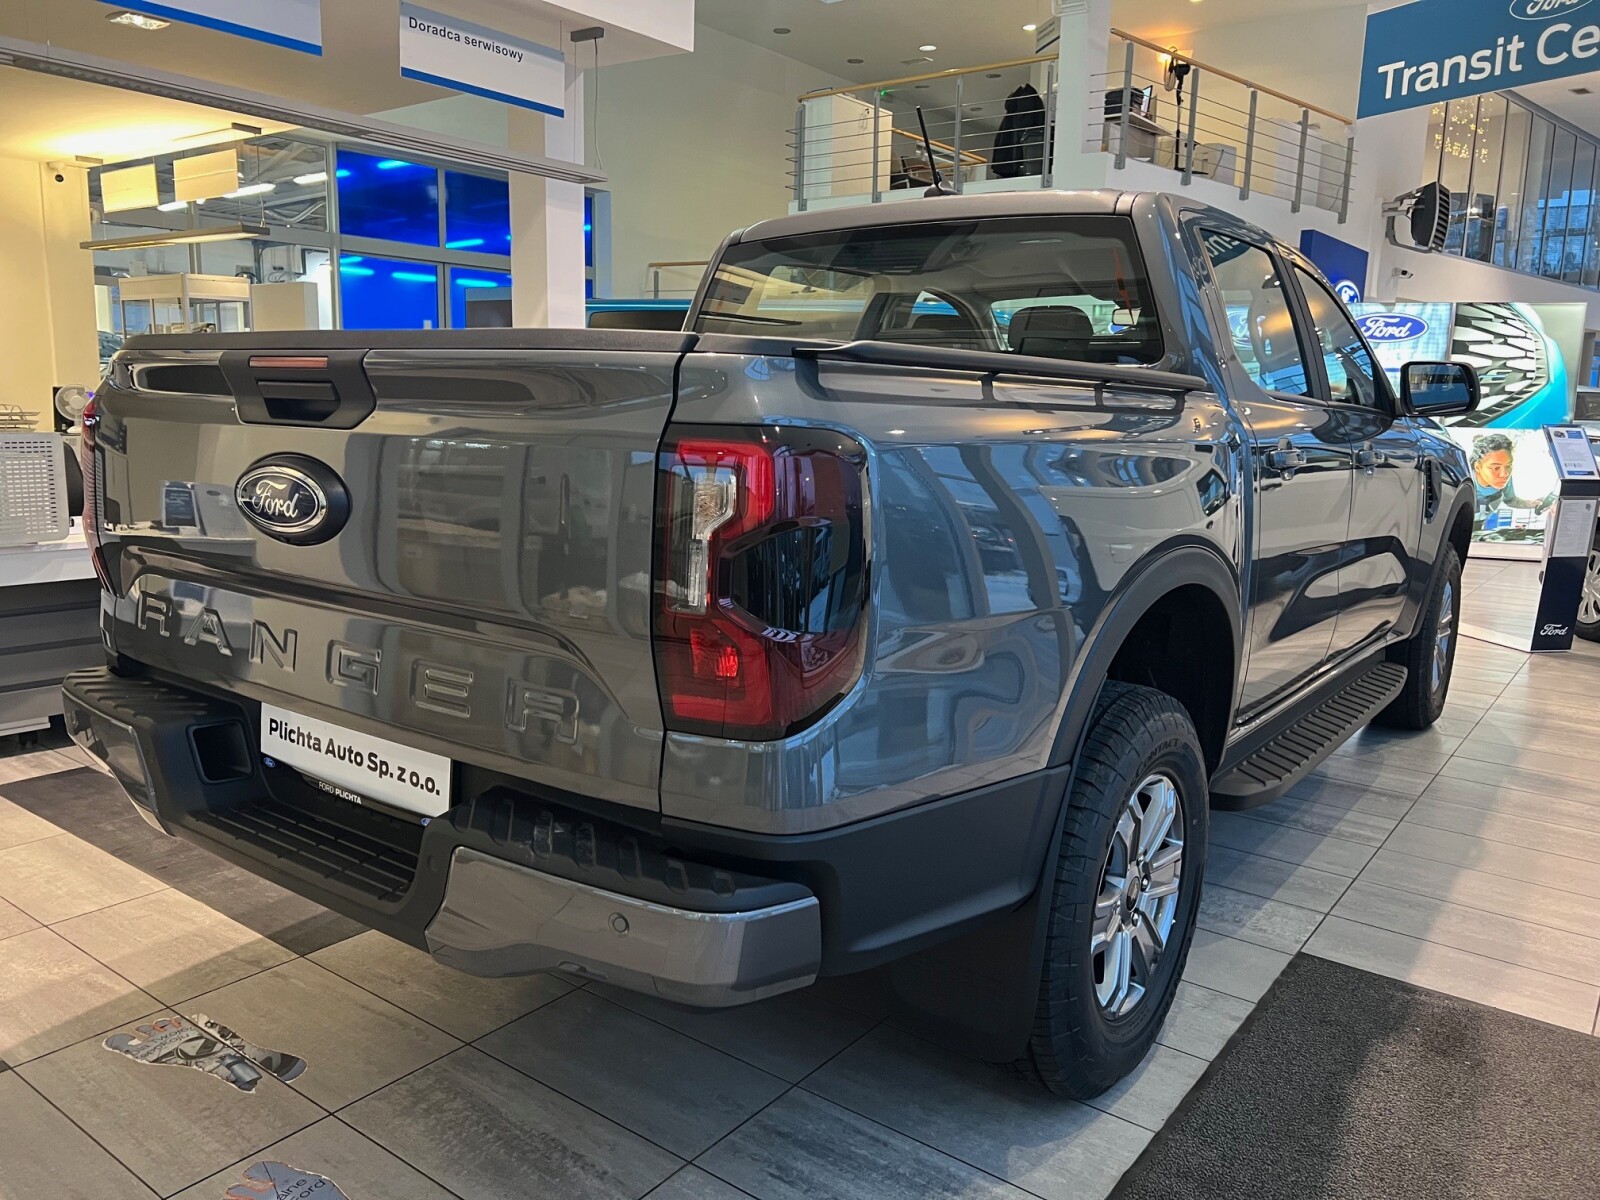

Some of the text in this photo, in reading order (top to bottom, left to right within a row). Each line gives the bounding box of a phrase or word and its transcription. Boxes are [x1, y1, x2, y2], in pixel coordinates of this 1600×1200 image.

[409, 16, 524, 62] Doradca serwisowy
[1378, 34, 1525, 100] Transit
[1361, 316, 1411, 338] Ford
[252, 479, 300, 518] Ford
[1539, 623, 1569, 636] Ford
[136, 591, 580, 746] RANGER
[268, 717, 441, 796] Plichta Auto Sp. z o.o.
[318, 781, 362, 805] FORD PLICHTA
